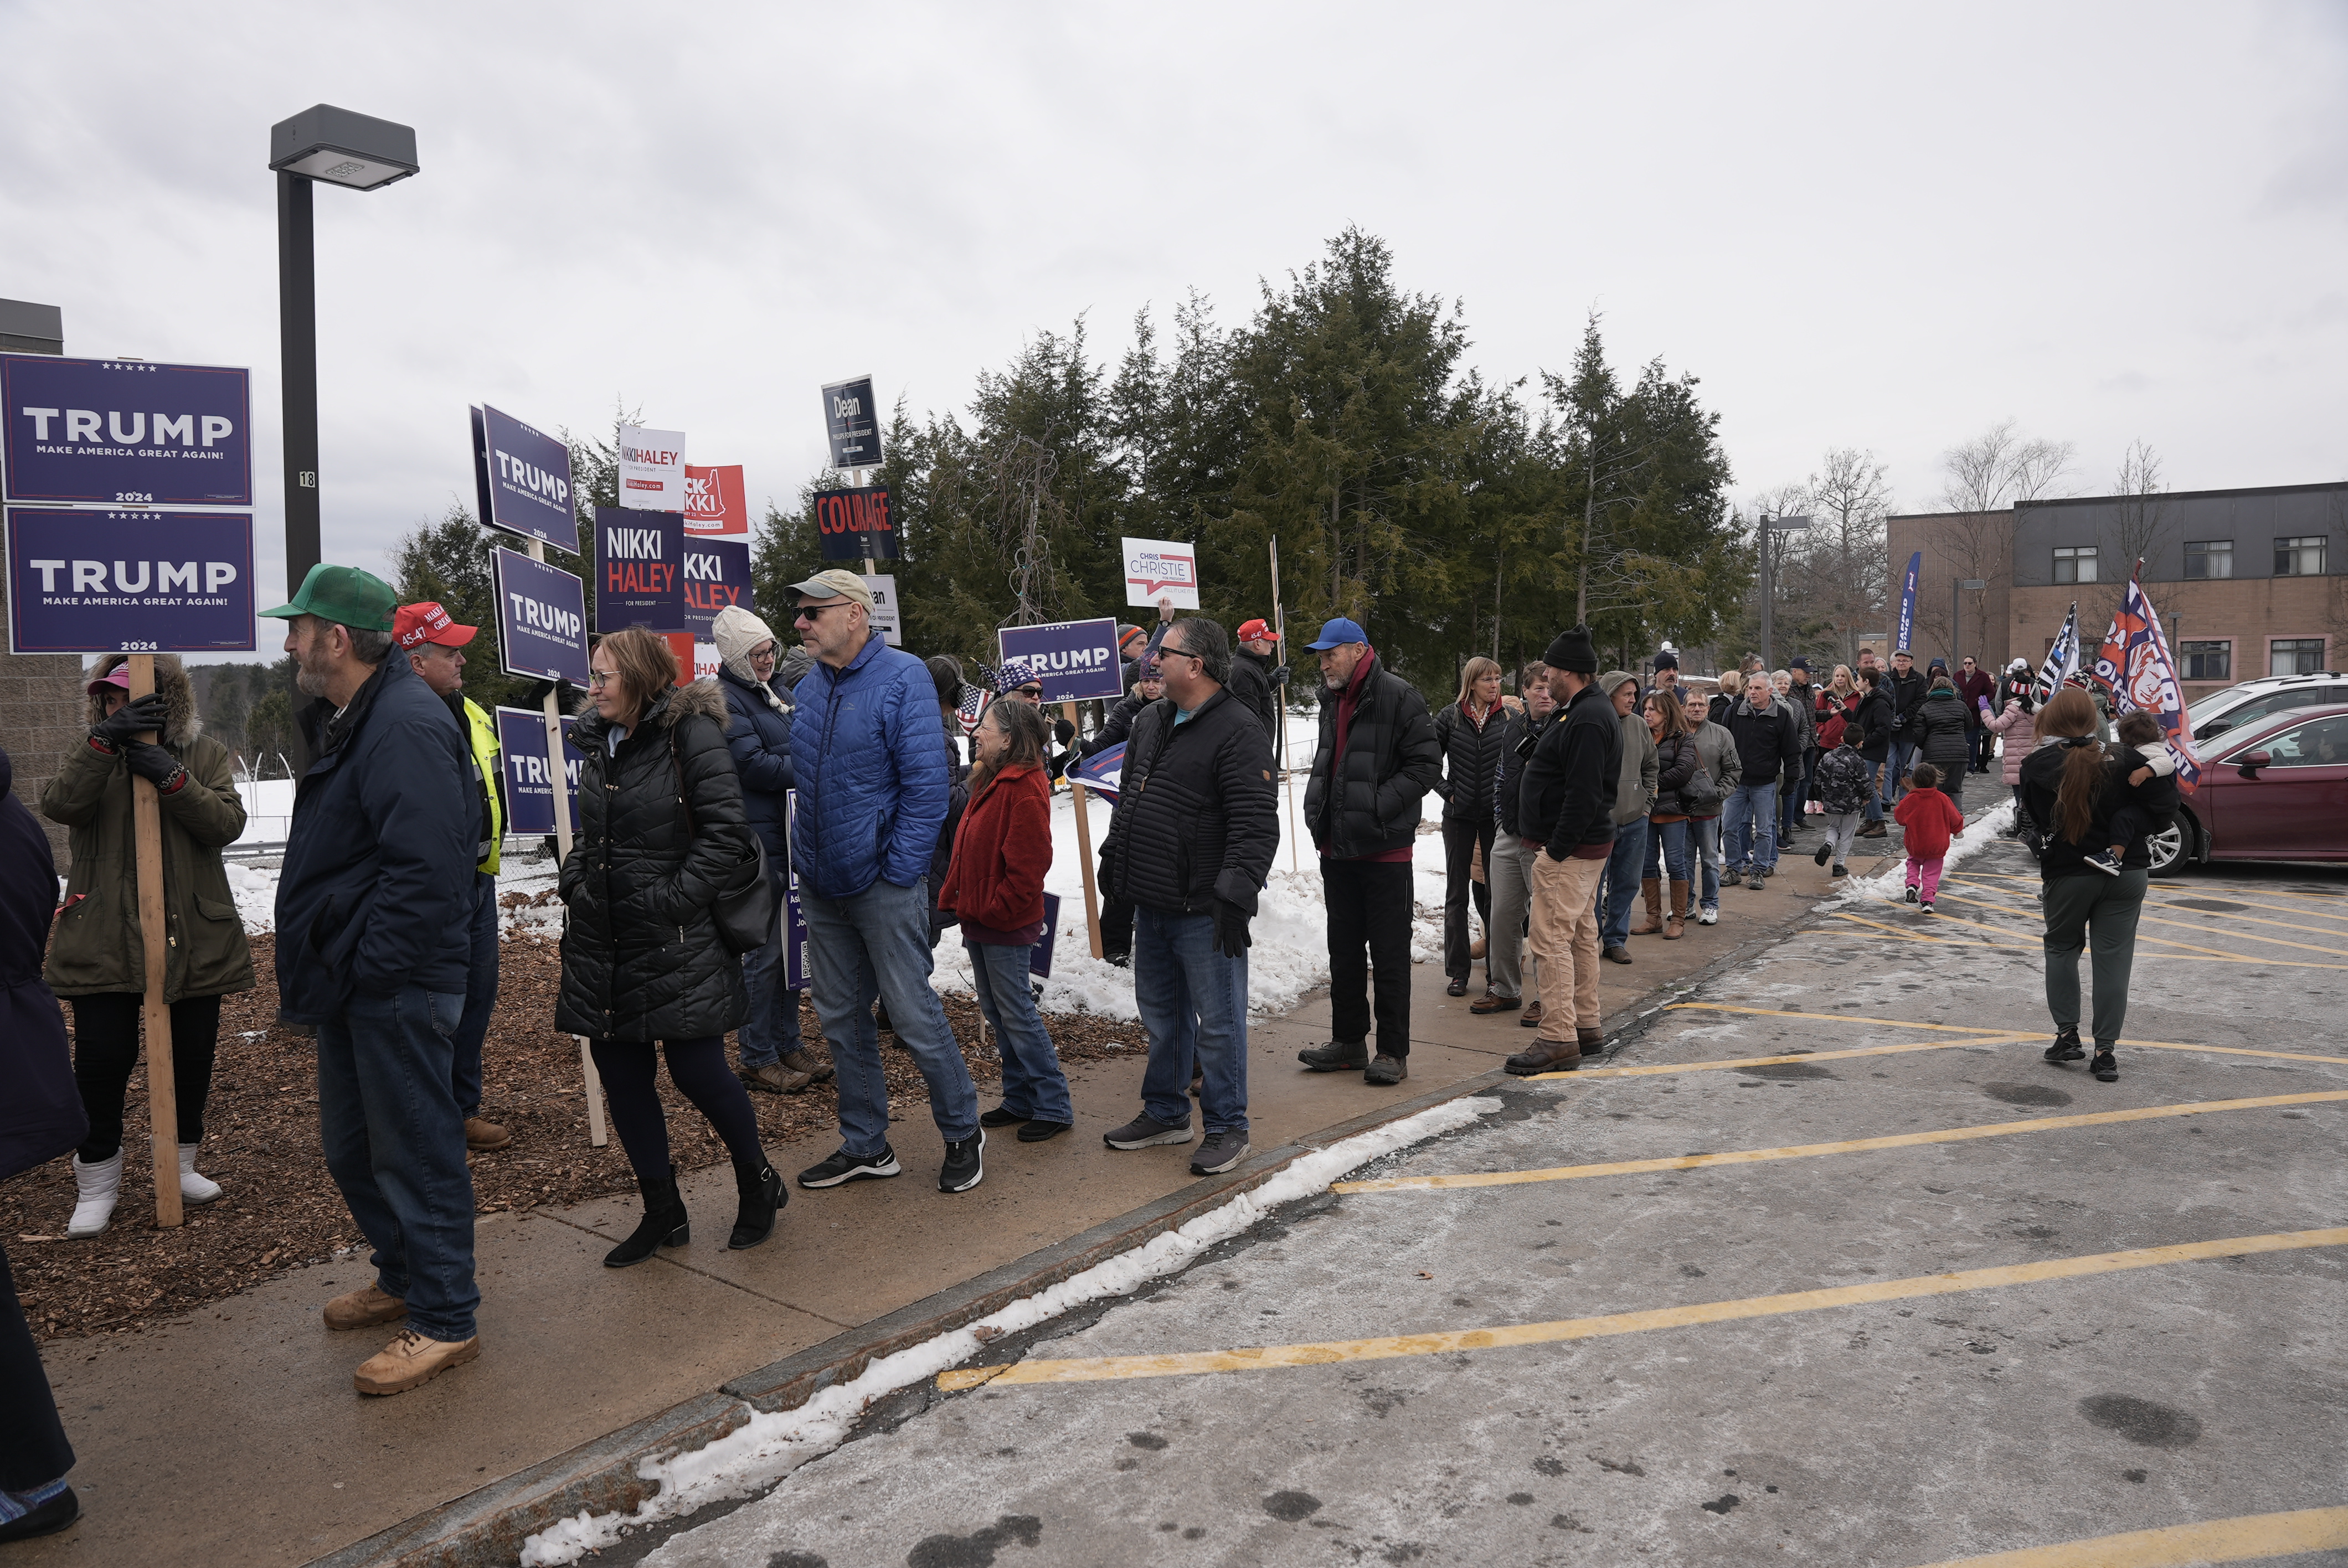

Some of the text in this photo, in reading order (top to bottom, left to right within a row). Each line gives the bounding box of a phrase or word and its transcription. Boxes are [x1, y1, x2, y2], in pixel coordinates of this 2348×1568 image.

[833, 396, 861, 419] Dean
[22, 406, 234, 447] TRUMP
[852, 428, 872, 438] PRESIDENT
[36, 445, 224, 460] MAKE AMERICA GREAT AGAIN!
[301, 472, 314, 486] 18
[495, 448, 568, 504] TRUMP
[684, 477, 708, 494] CK
[115, 492, 153, 502] 2024
[502, 481, 568, 514] MAKE AMERICA GREAT AGAIN!
[684, 493, 715, 512] KKI
[817, 492, 892, 535] COURAGE
[684, 520, 720, 528] kiHaley.com
[533, 528, 548, 540] 2024
[607, 527, 662, 560] NIKKI
[29, 559, 238, 594] TRUMP
[684, 552, 723, 582] KKI
[1130, 560, 1185, 576] CHRISTIE
[607, 561, 675, 593] HALEY
[43, 597, 228, 606] MAKE AMERICA GREAT AGAIN!
[684, 582, 740, 610] ALEY
[424, 606, 442, 623] MAKE
[509, 592, 581, 639] TRUMP
[1898, 597, 1908, 647] CAPPED
[402, 626, 426, 646] 45-47
[517, 624, 580, 650] MAKE AMERICA GREAT AGAIN!
[1250, 631, 1261, 639] 45-47
[120, 641, 158, 651] 2024
[547, 668, 561, 679] 2024
